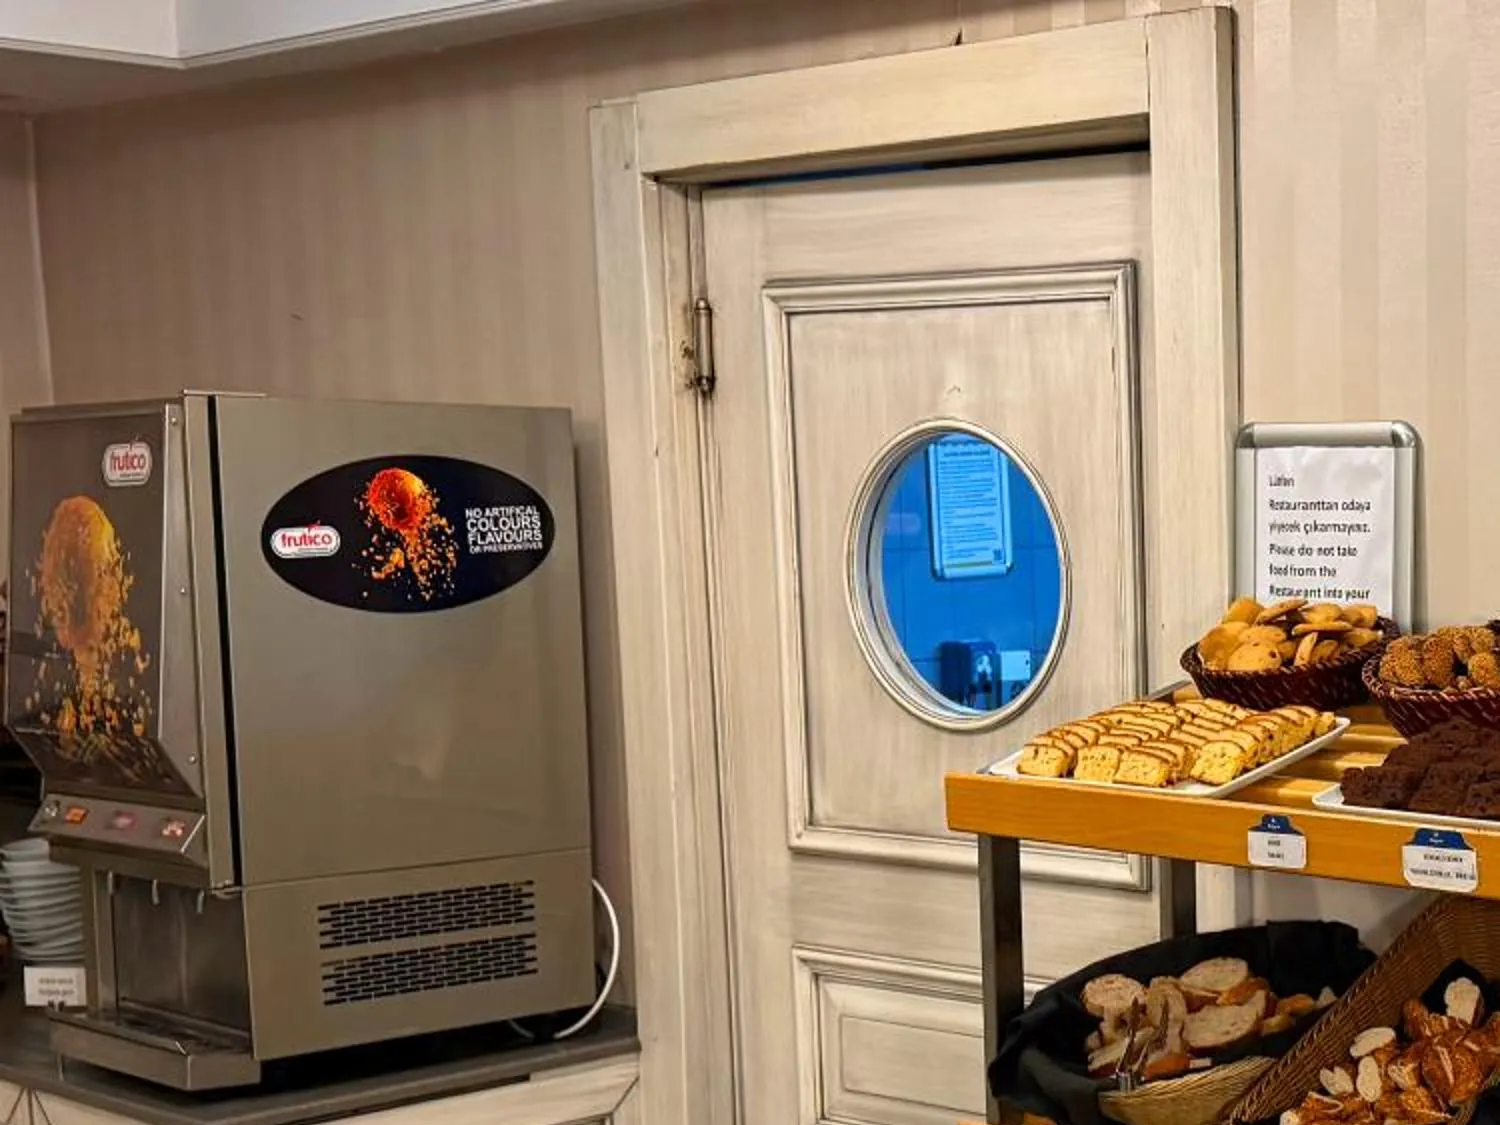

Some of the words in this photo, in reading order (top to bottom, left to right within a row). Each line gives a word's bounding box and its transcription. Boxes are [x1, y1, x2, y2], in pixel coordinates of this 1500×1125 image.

[465, 507, 483, 518] NO
[1269, 499, 1339, 511] Restauranttan
[1341, 499, 1371, 513] odaya
[467, 515, 541, 532] COLOURS
[468, 529, 543, 545] FLAVOURS
[1269, 543, 1295, 556] Please
[1297, 544, 1313, 557] do
[1316, 546, 1335, 557] not
[1337, 545, 1358, 557] take
[1290, 564, 1317, 577] from
[1319, 564, 1337, 578] the
[1269, 584, 1322, 598] Restaurant
[1323, 585, 1343, 598] into
[1345, 588, 1371, 600] your
